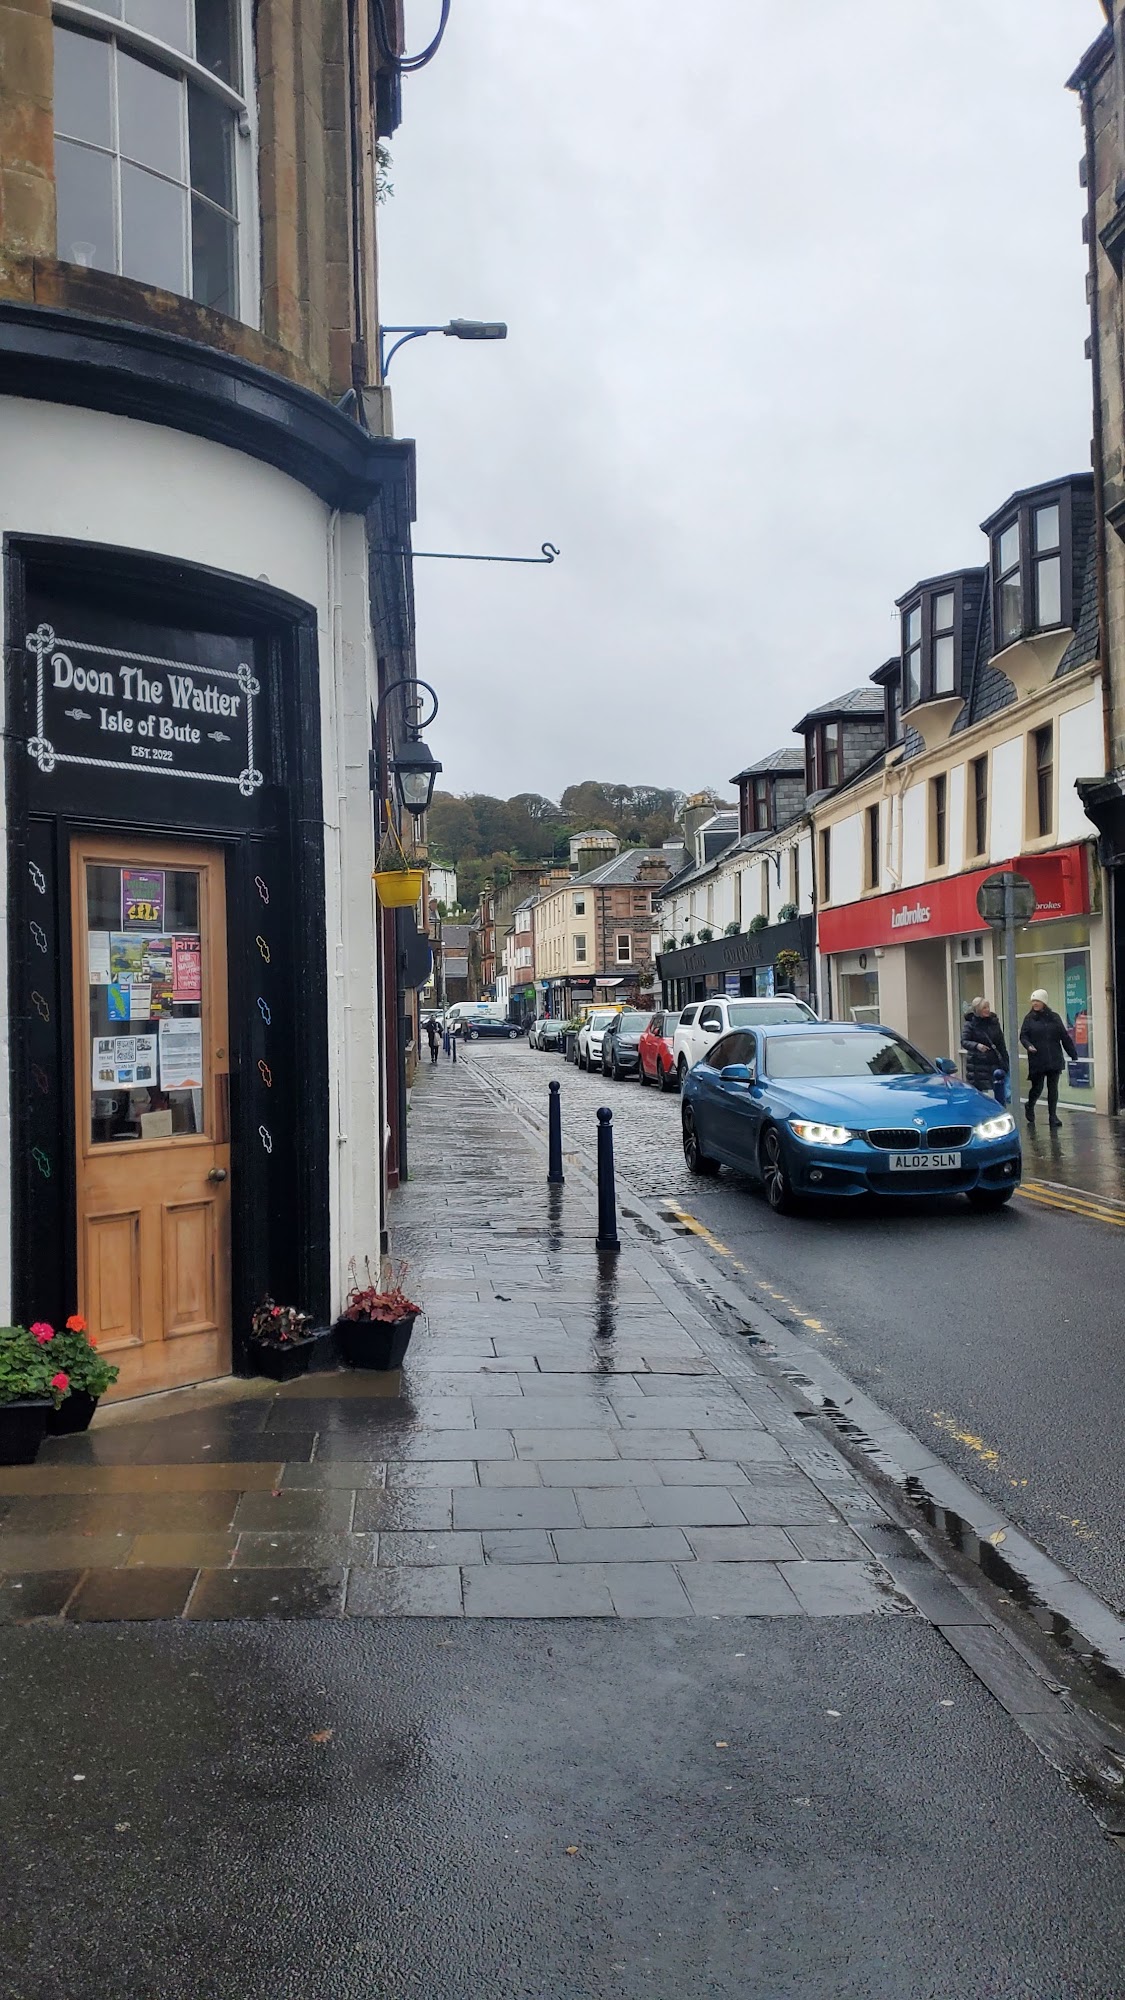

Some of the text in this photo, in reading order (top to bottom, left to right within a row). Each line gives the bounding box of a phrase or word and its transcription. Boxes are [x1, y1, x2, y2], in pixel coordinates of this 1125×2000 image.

[51, 652, 241, 717] Doon The Watter
[99, 707, 200, 744] Isle of Bute
[131, 745, 173, 762] EST. 2022
[1036, 901, 1062, 910] brokes
[891, 902, 931, 928] Ladbrokes
[175, 941, 200, 950] RITZ
[895, 1154, 956, 1168] AL02 SLN
